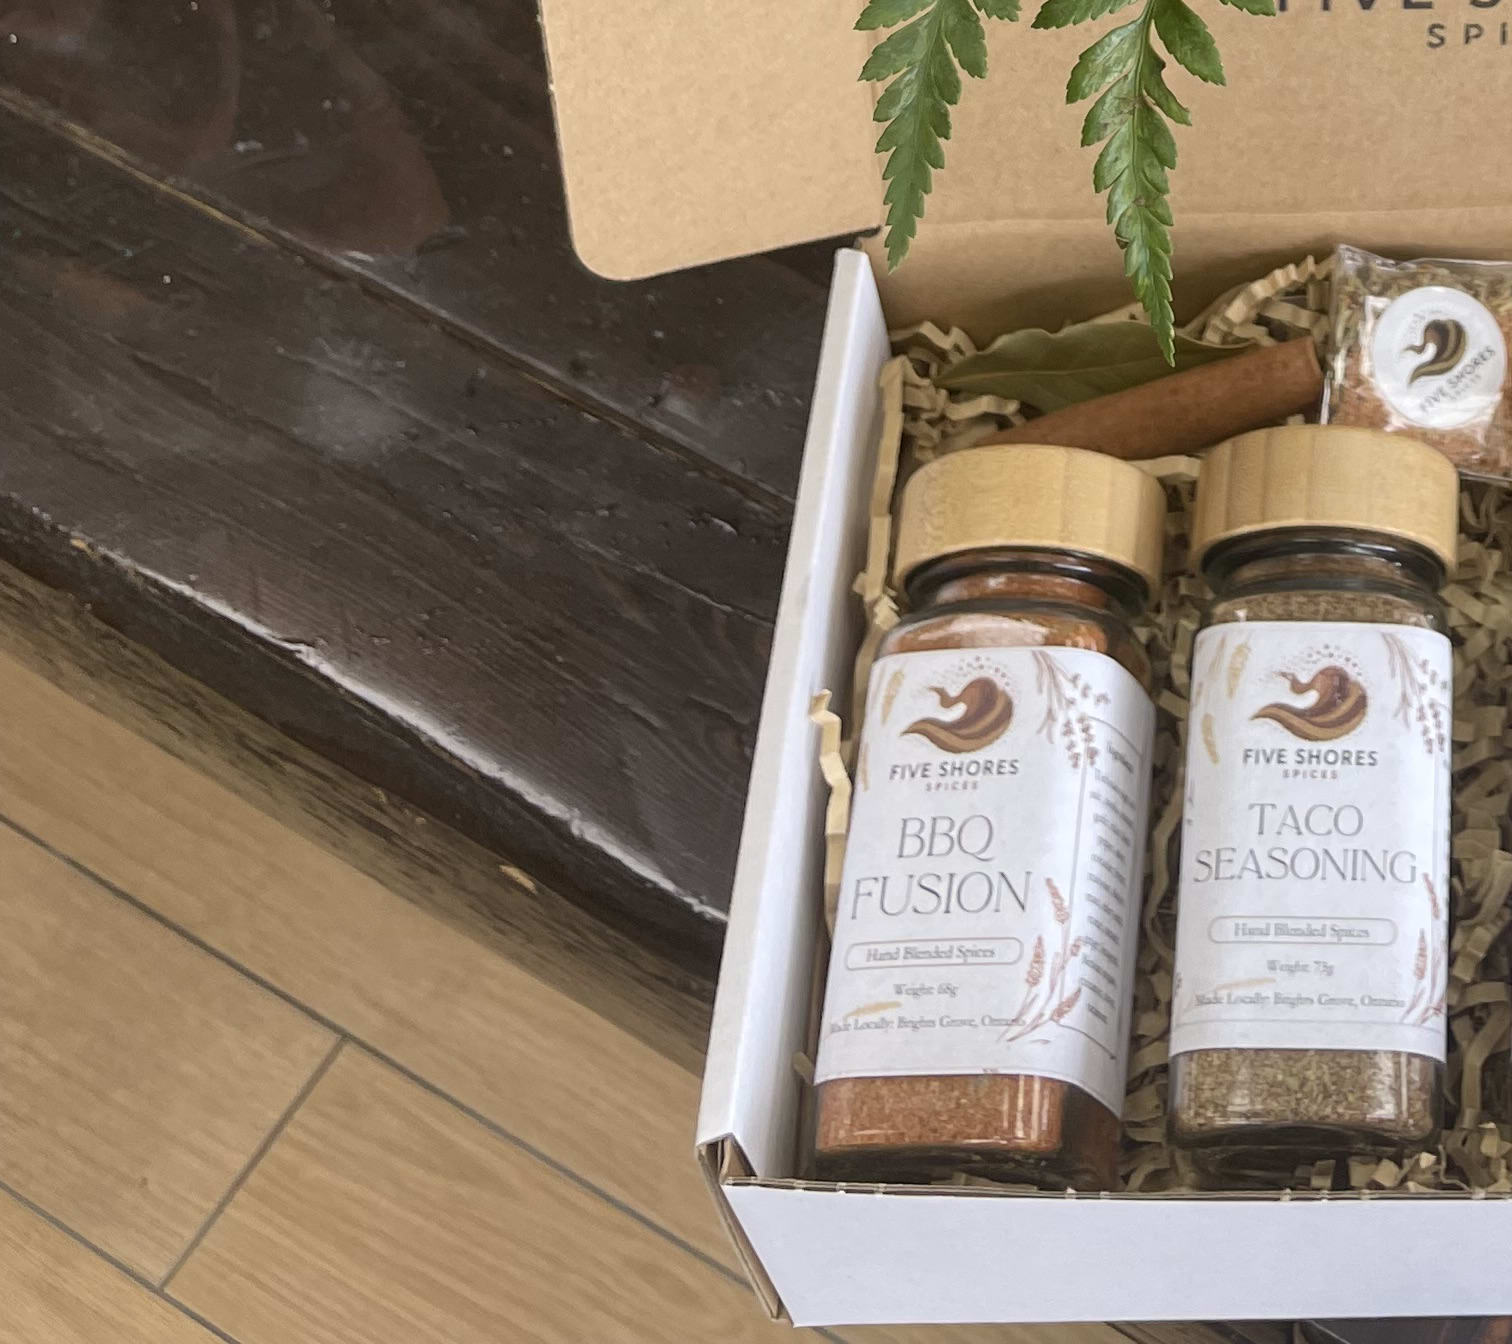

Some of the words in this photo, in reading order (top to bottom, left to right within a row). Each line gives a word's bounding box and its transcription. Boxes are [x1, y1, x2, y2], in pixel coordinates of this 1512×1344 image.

[1419, 386, 1447, 413] FIVE
[1447, 345, 1496, 386] SHORES
[1242, 748, 1287, 766] FIVE
[1295, 748, 1379, 767] SHORES
[889, 761, 931, 781] FIVE
[937, 758, 1020, 779] SHORES
[1282, 769, 1339, 780] SPICES
[925, 780, 979, 792] SPICES
[1248, 802, 1365, 837] TACO
[897, 813, 995, 862] BBQ
[1193, 847, 1417, 884] SEASONING
[850, 870, 1033, 920] FUSION
[1234, 923, 1271, 937] Hand
[1274, 923, 1327, 938] Blended
[1330, 924, 1370, 942] Spices
[865, 947, 900, 962] Hand
[903, 945, 954, 960] Blended
[955, 945, 995, 963] Spices
